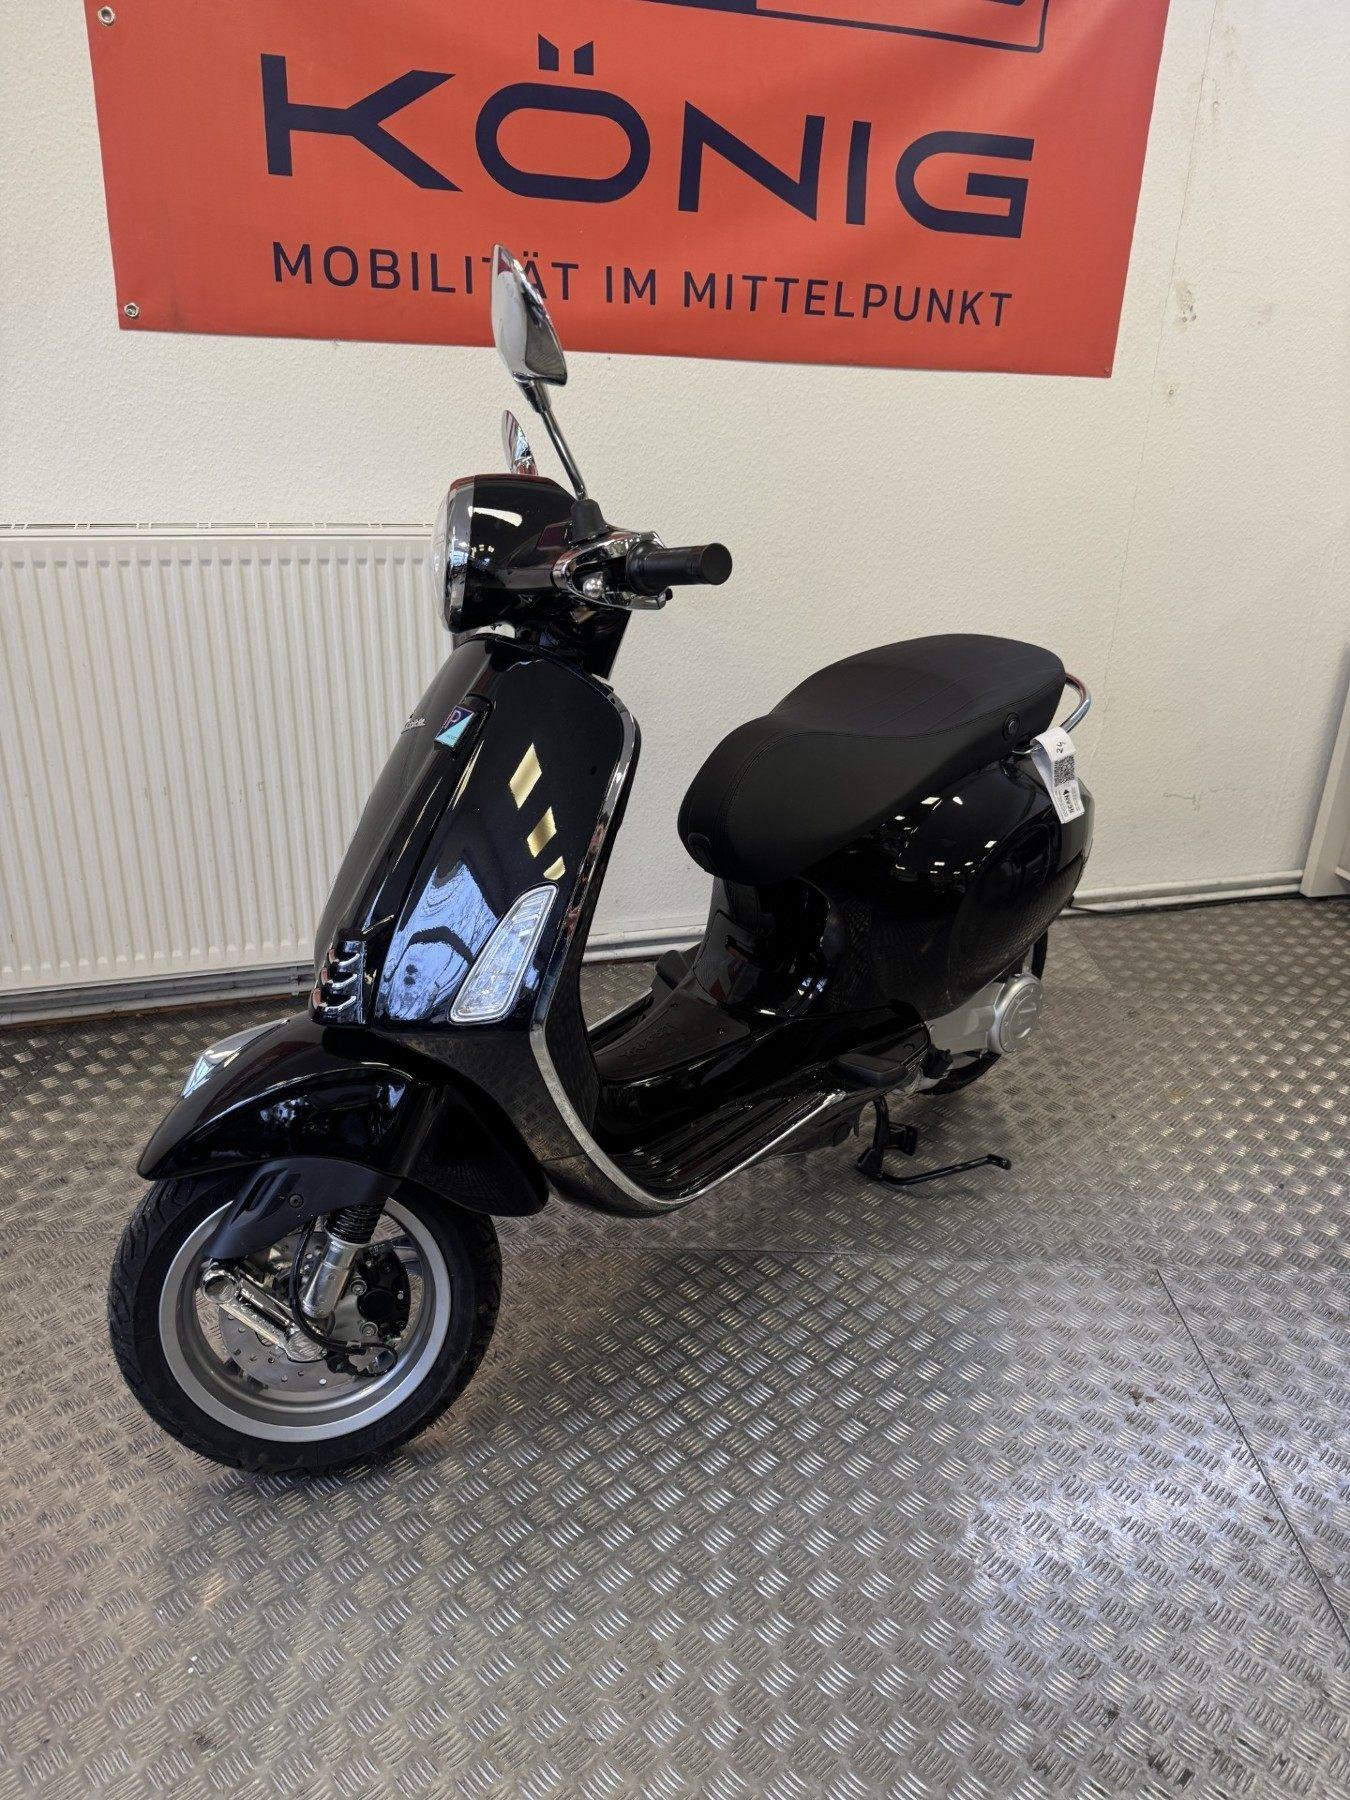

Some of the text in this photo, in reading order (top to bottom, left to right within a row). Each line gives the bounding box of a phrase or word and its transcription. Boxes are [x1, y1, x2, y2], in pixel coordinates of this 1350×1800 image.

[260, 33, 1035, 239] KÖNIG
[273, 241, 1013, 327] MOBILIÄT IM MITTELPUNKT
